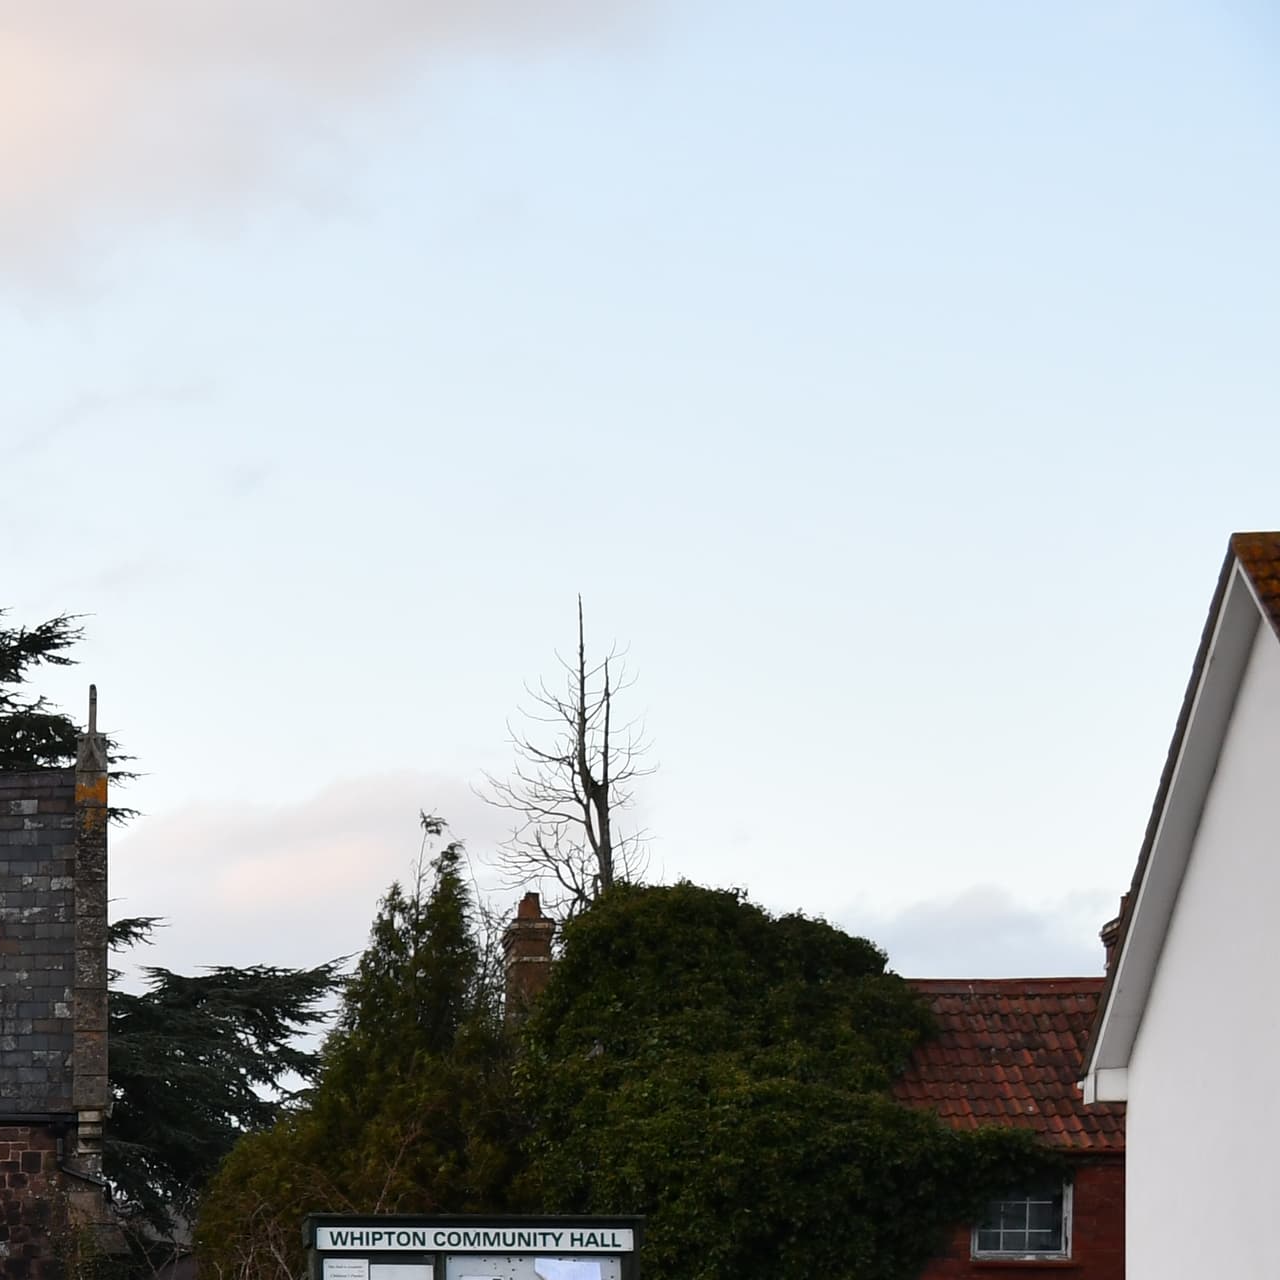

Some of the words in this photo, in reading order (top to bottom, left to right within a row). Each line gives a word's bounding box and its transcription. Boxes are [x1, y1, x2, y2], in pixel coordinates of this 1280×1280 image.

[329, 1231, 426, 1247] WHIPTON
[433, 1231, 562, 1247] COMMUNITY
[570, 1232, 622, 1248] HALL
